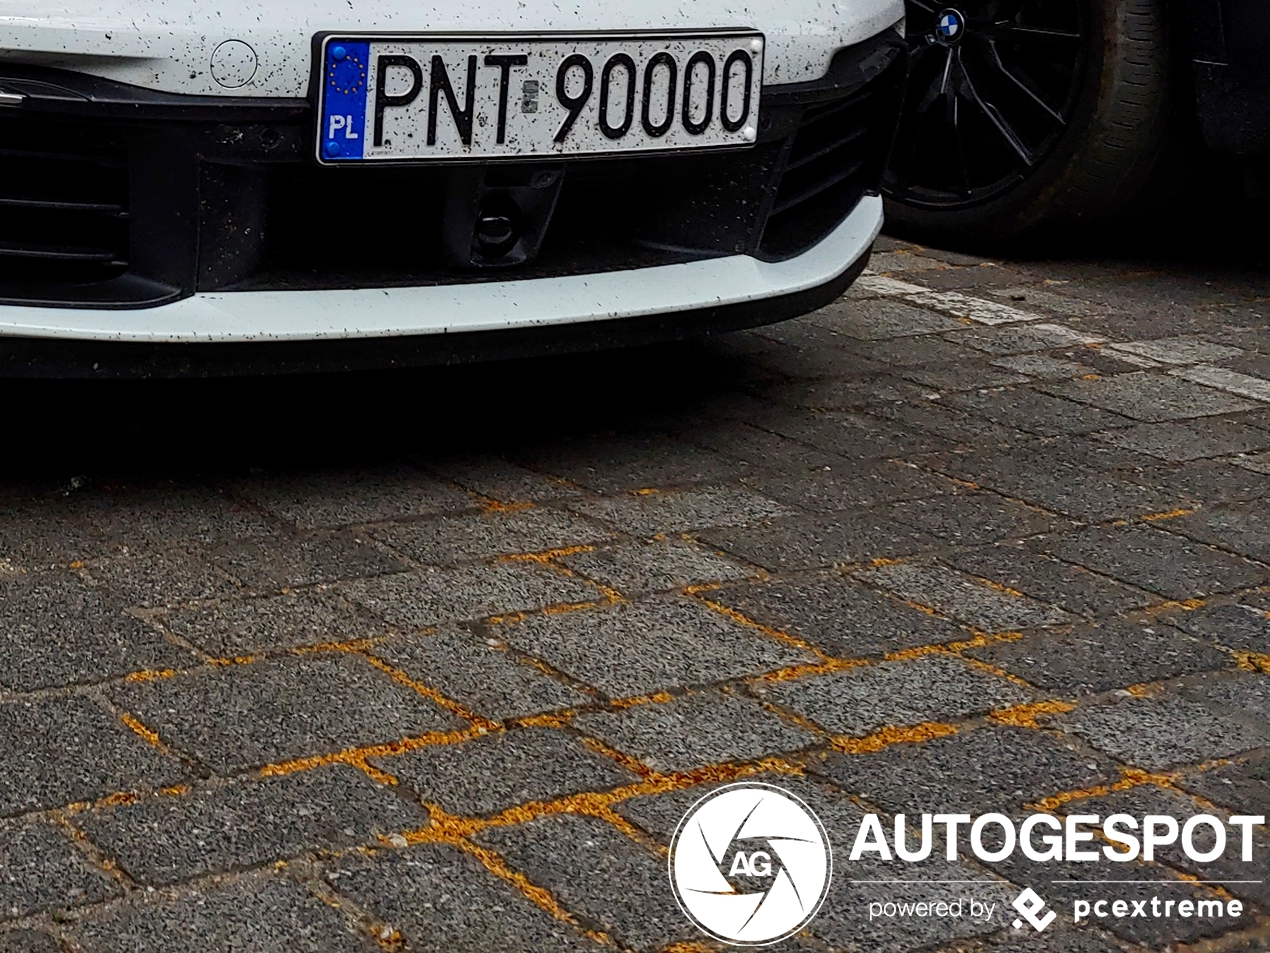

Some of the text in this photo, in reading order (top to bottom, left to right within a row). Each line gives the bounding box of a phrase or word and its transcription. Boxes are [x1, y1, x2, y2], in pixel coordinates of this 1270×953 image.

[329, 115, 358, 139] PL
[373, 49, 754, 147] PNT 90000
